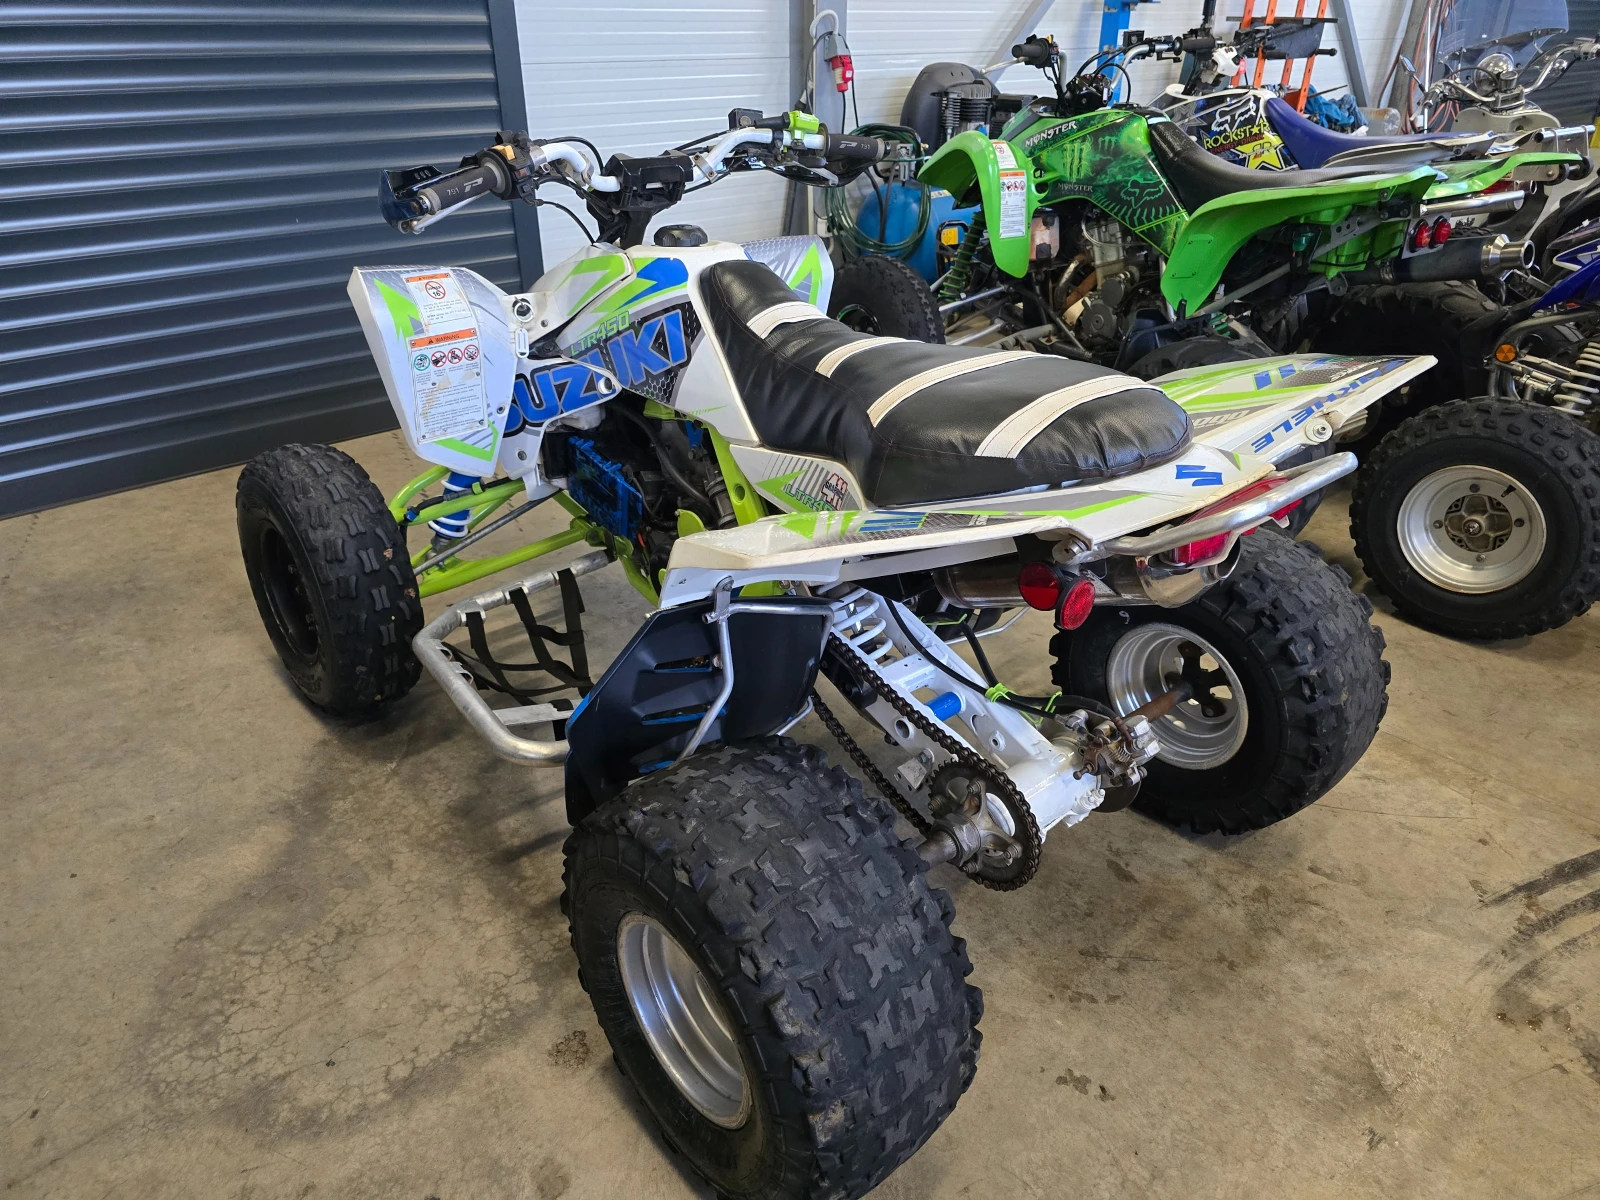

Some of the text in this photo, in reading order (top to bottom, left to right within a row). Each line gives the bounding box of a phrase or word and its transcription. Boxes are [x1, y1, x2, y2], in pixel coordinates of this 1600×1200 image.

[1025, 120, 1077, 147] MONSTER
[446, 187, 459, 196] 791
[1057, 183, 1093, 193] MONSTER
[435, 333, 461, 342] WARNING
[570, 310, 630, 356] LTR450
